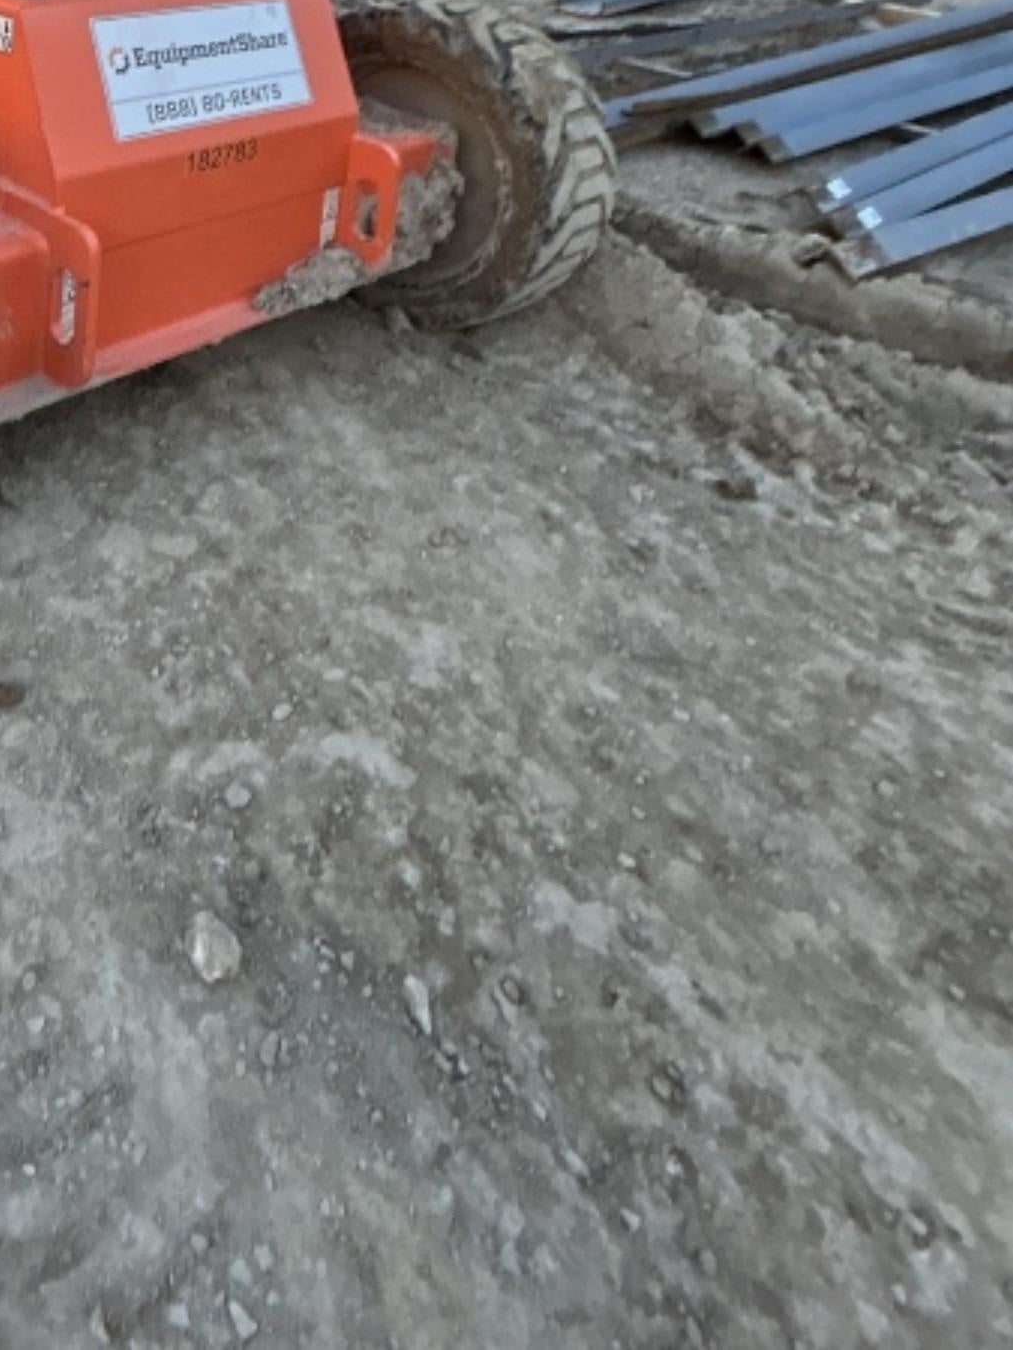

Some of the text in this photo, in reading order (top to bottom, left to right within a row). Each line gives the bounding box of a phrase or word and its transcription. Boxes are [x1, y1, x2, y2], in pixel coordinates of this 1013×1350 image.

[132, 31, 288, 70] EquipmentShare
[201, 83, 283, 113] 80-RENTS
[187, 138, 259, 172] 182783
